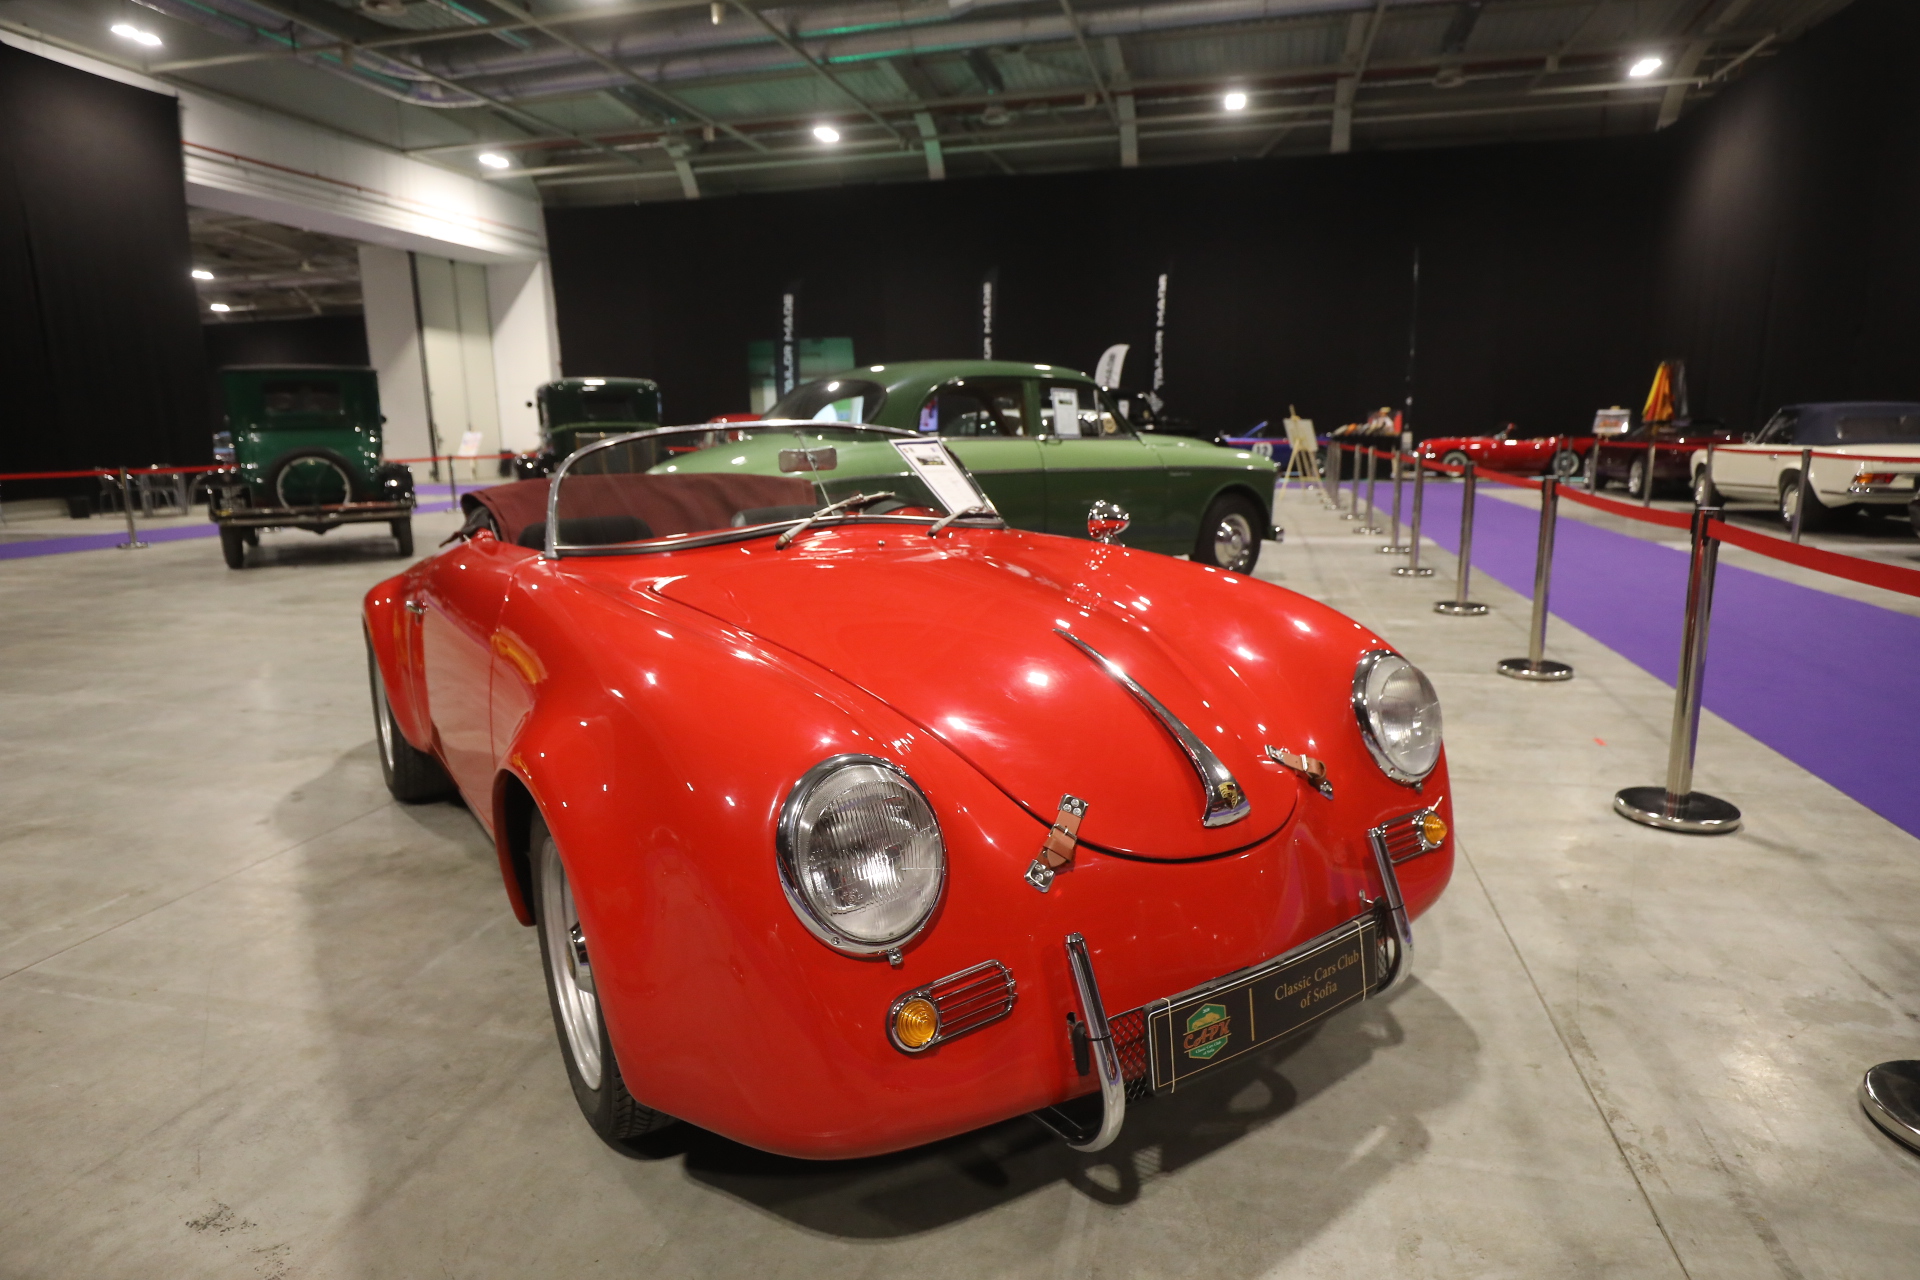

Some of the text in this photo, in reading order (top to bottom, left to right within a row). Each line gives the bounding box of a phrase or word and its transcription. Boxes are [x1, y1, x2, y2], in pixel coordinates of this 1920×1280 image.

[1274, 949, 1360, 1001] Classic Cars Club
[1300, 981, 1338, 1009] of Sofia
